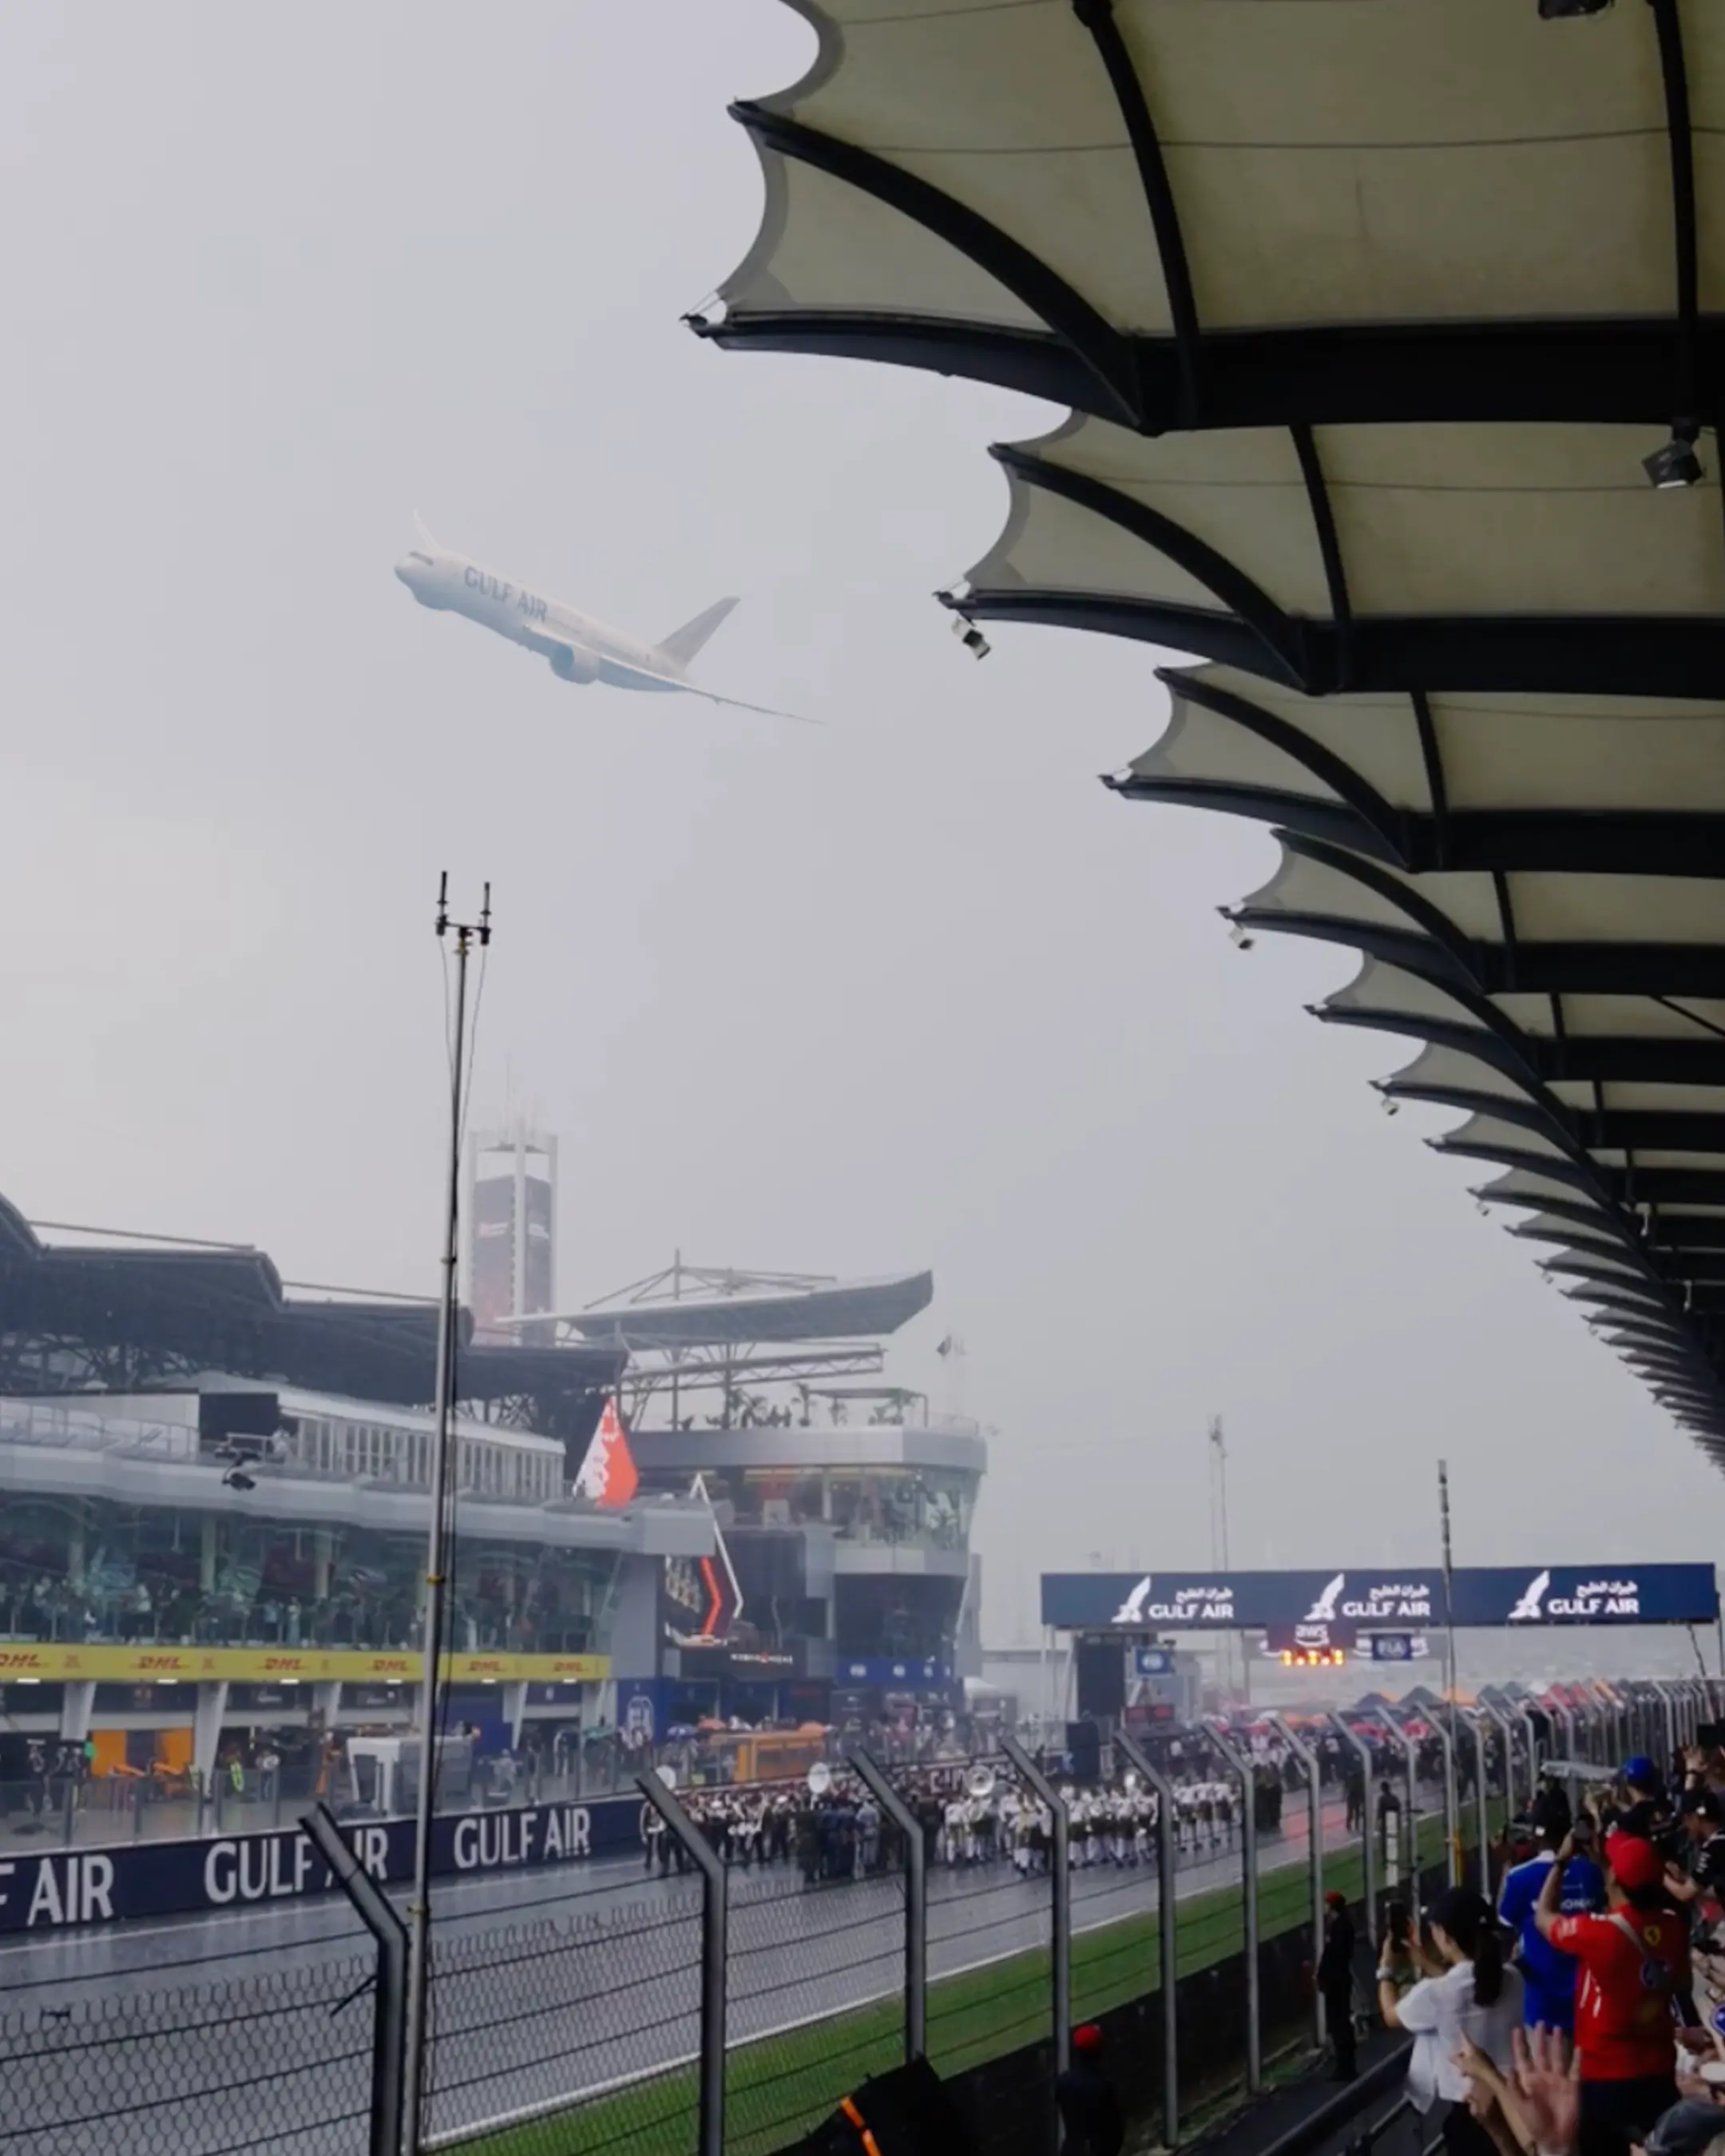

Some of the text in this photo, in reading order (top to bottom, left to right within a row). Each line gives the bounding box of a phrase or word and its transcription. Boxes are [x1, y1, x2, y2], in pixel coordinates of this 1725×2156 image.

[464, 565, 547, 623] GULF AIR
[1148, 1603, 1234, 1619] GULF AIR
[1342, 1601, 1430, 1617] GULF AIR
[1548, 1598, 1639, 1615] GULF AIR
[138, 1656, 181, 1670] DHL
[264, 1658, 310, 1671] DHL
[372, 1659, 407, 1672] DHL
[453, 1808, 591, 1869] GULF AIR
[204, 1827, 388, 1904] GULF IR
[27, 1854, 114, 1927] AIR
